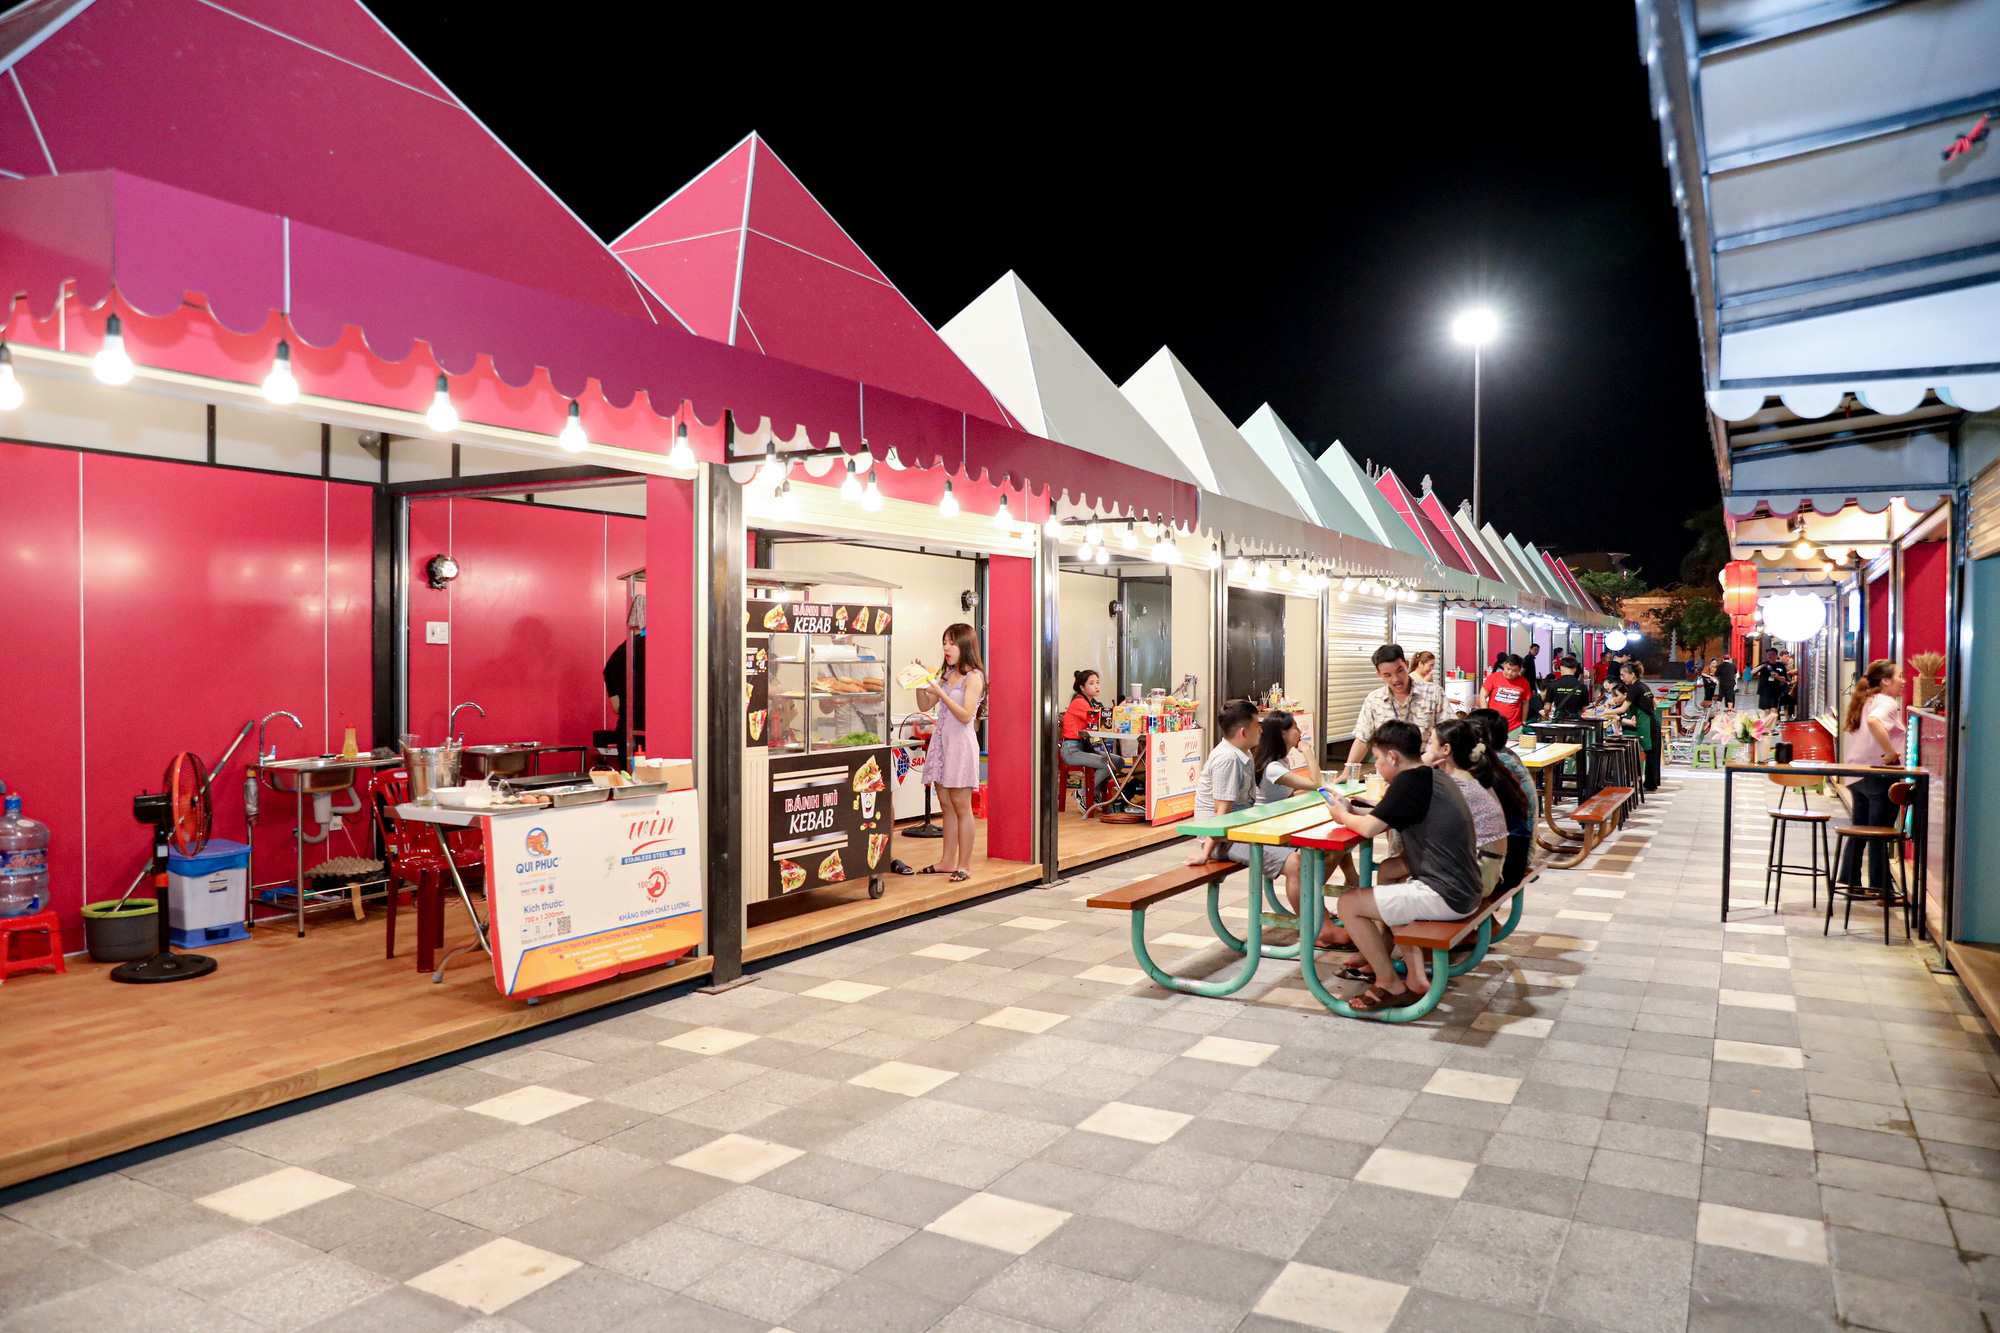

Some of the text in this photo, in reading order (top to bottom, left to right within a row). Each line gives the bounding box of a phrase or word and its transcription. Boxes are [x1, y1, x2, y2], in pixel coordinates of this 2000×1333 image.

[794, 617, 832, 632] KEBAB
[785, 789, 838, 813] BÁNH MÌ
[790, 808, 834, 834] KEBAB
[624, 854, 652, 864] STAINLESS
[516, 862, 533, 874] QUI
